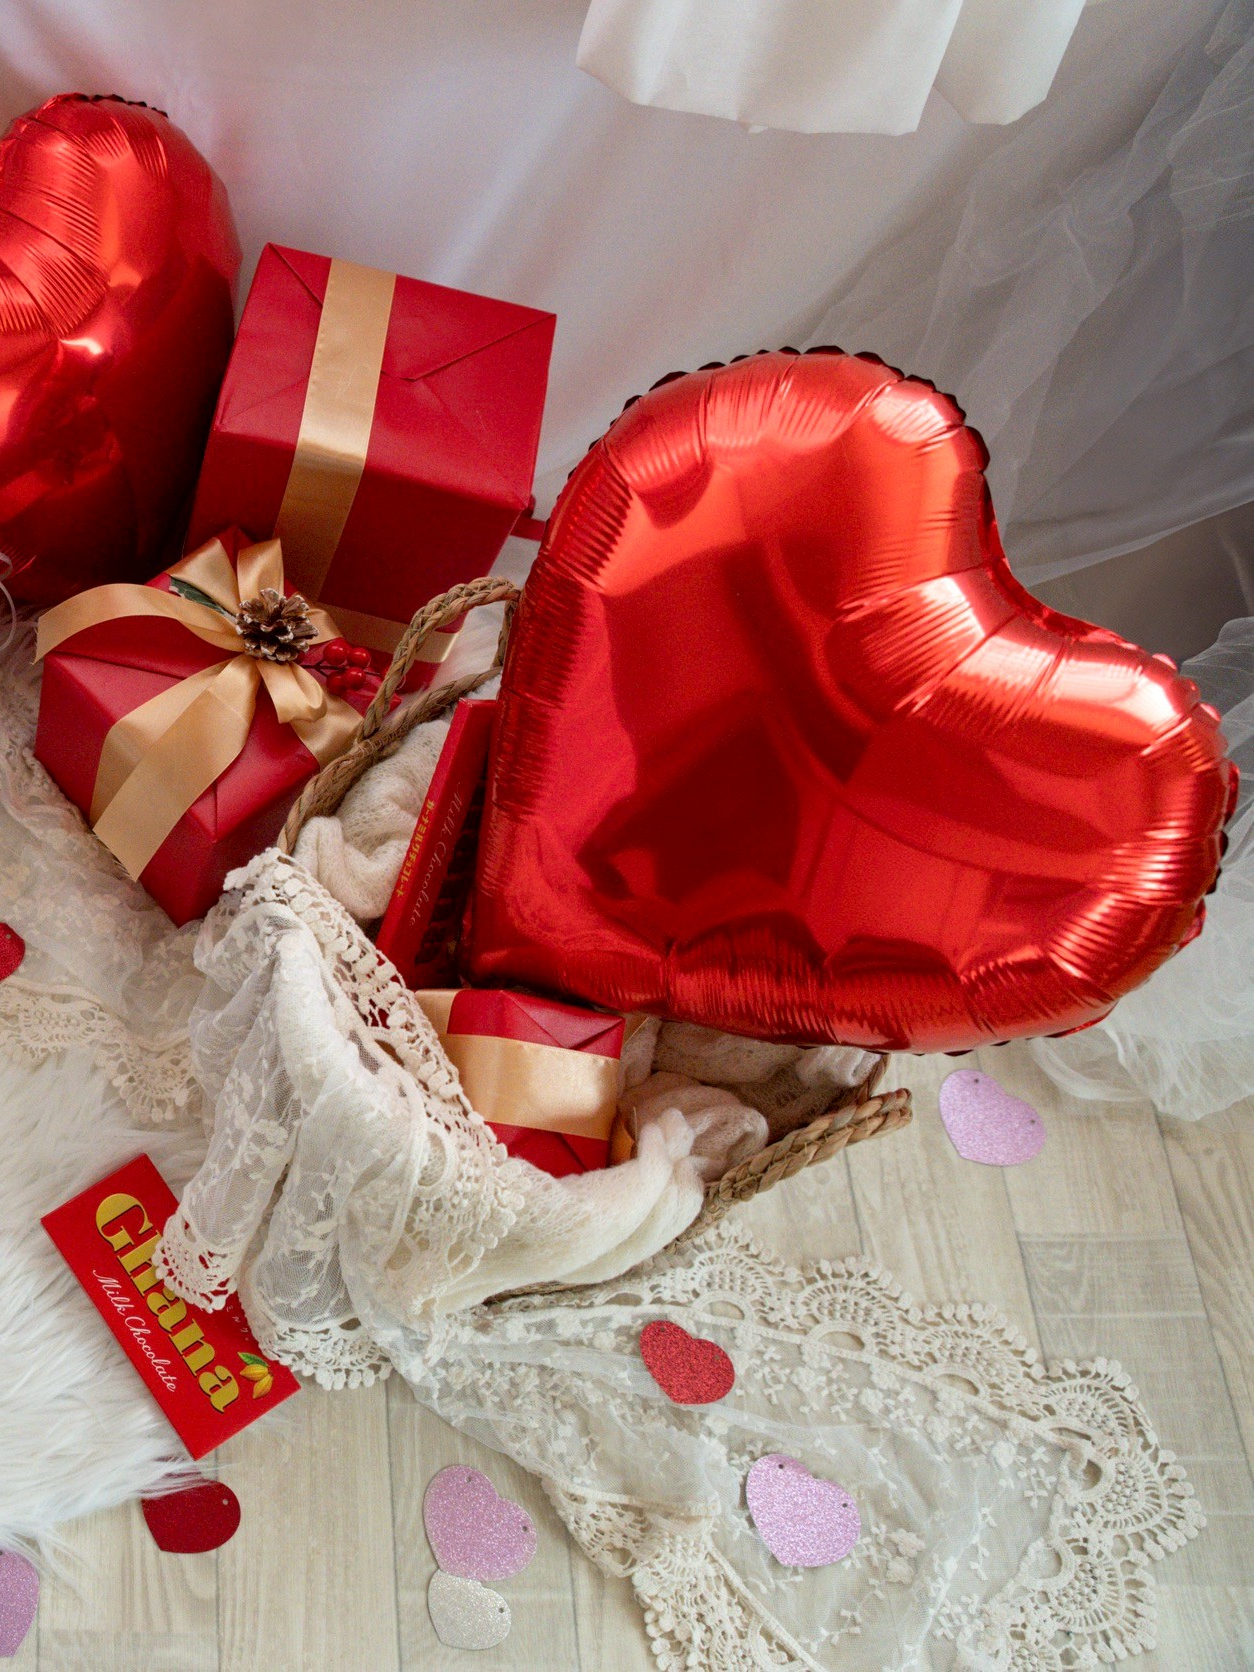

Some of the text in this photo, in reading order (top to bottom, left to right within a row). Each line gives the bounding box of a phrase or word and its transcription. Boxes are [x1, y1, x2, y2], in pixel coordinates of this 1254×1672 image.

[396, 799, 435, 898] ガーナミルクチョコレート
[408, 781, 463, 927] Milk Chocolate
[92, 1269, 176, 1393] Milk Chocolate
